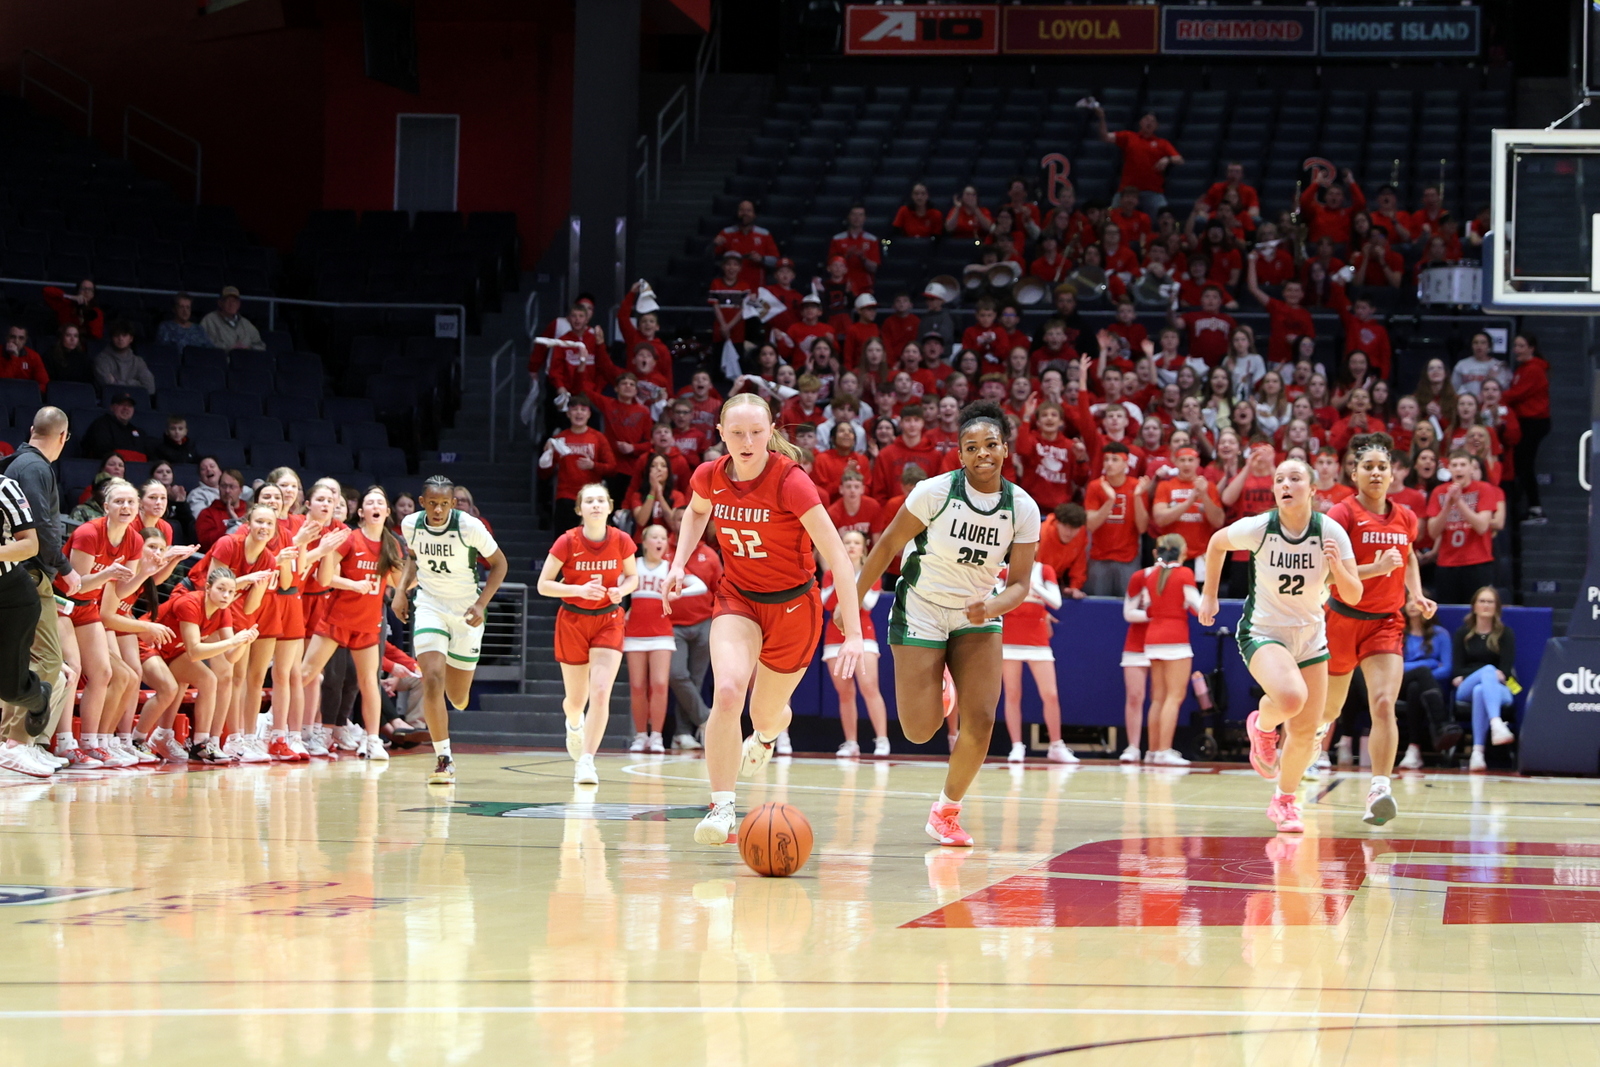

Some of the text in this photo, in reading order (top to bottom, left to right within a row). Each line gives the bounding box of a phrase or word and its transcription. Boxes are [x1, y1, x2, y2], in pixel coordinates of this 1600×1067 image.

[1038, 20, 1121, 40] LOYOLA
[1176, 19, 1302, 41] RICHMOND
[1331, 21, 1470, 41] RHODE ISLAND
[441, 452, 456, 463] 107
[713, 503, 770, 523] BELLEVUE
[720, 526, 768, 559] 32
[949, 518, 1001, 547] LAUREL
[1361, 531, 1409, 546] BELLEVUE
[419, 541, 455, 557] LAUREL
[956, 546, 988, 566] 25
[356, 559, 379, 570] BELLE
[427, 559, 452, 574] 24
[574, 558, 618, 571] BELLEVUE
[1269, 550, 1315, 570] LAUREL
[1278, 574, 1305, 596] 22
